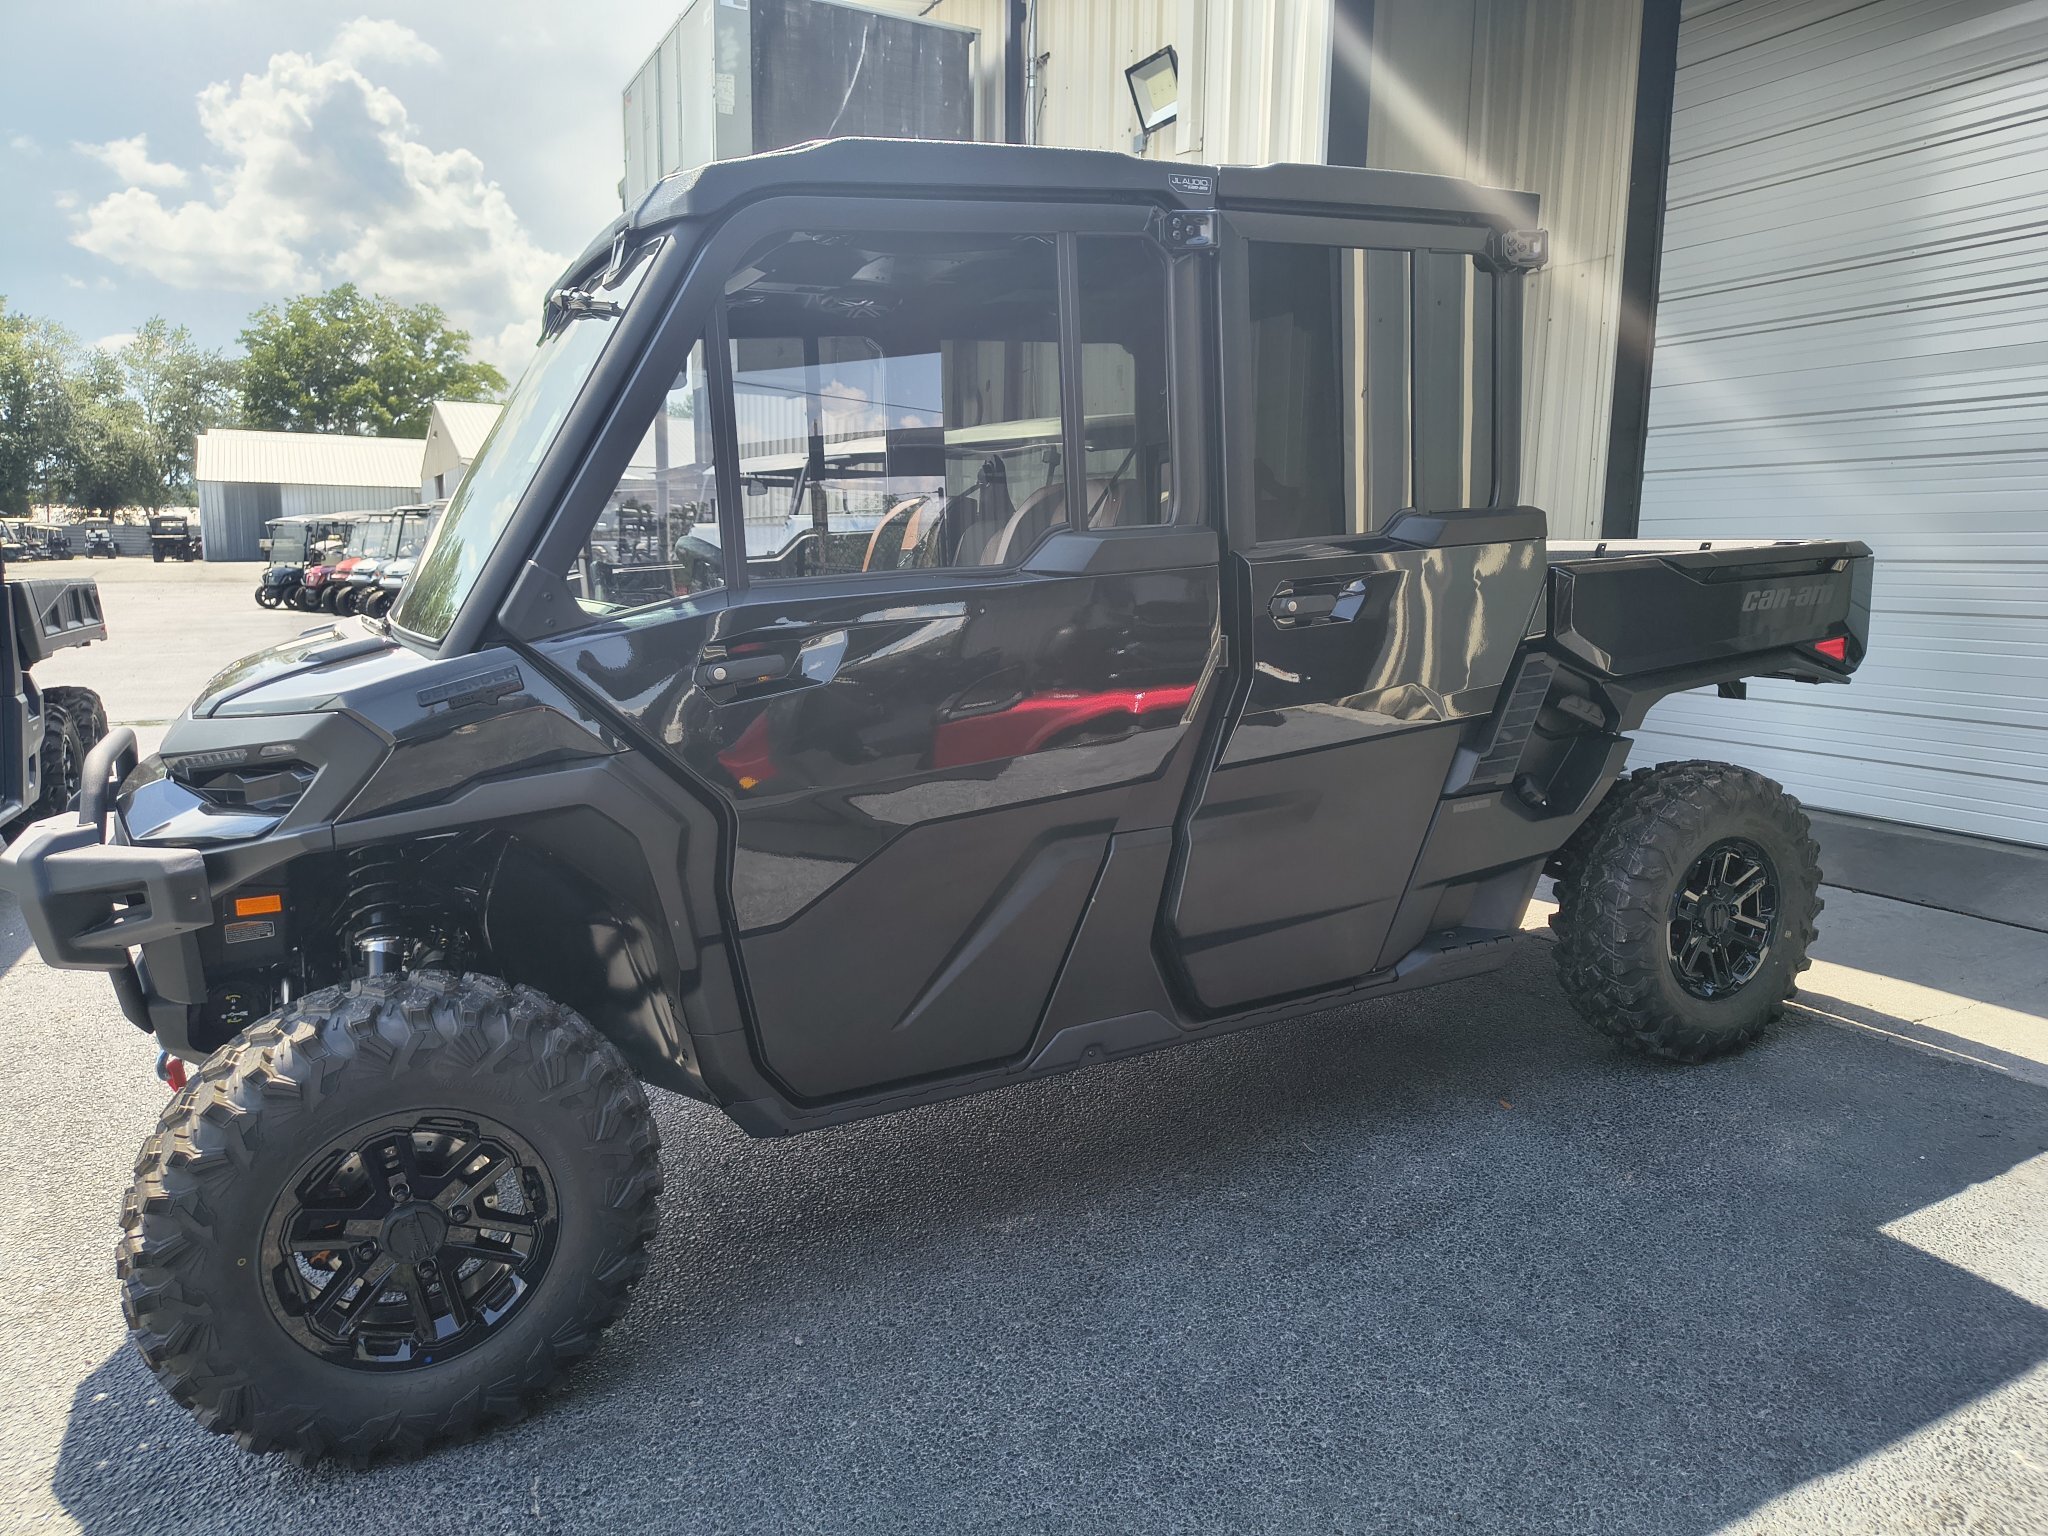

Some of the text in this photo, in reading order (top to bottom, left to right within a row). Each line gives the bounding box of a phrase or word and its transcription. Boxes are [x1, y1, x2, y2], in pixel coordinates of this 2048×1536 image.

[1182, 178, 1208, 186] AUDIO
[1741, 584, 1835, 612] can-am
[420, 667, 518, 702] DEFENDER
